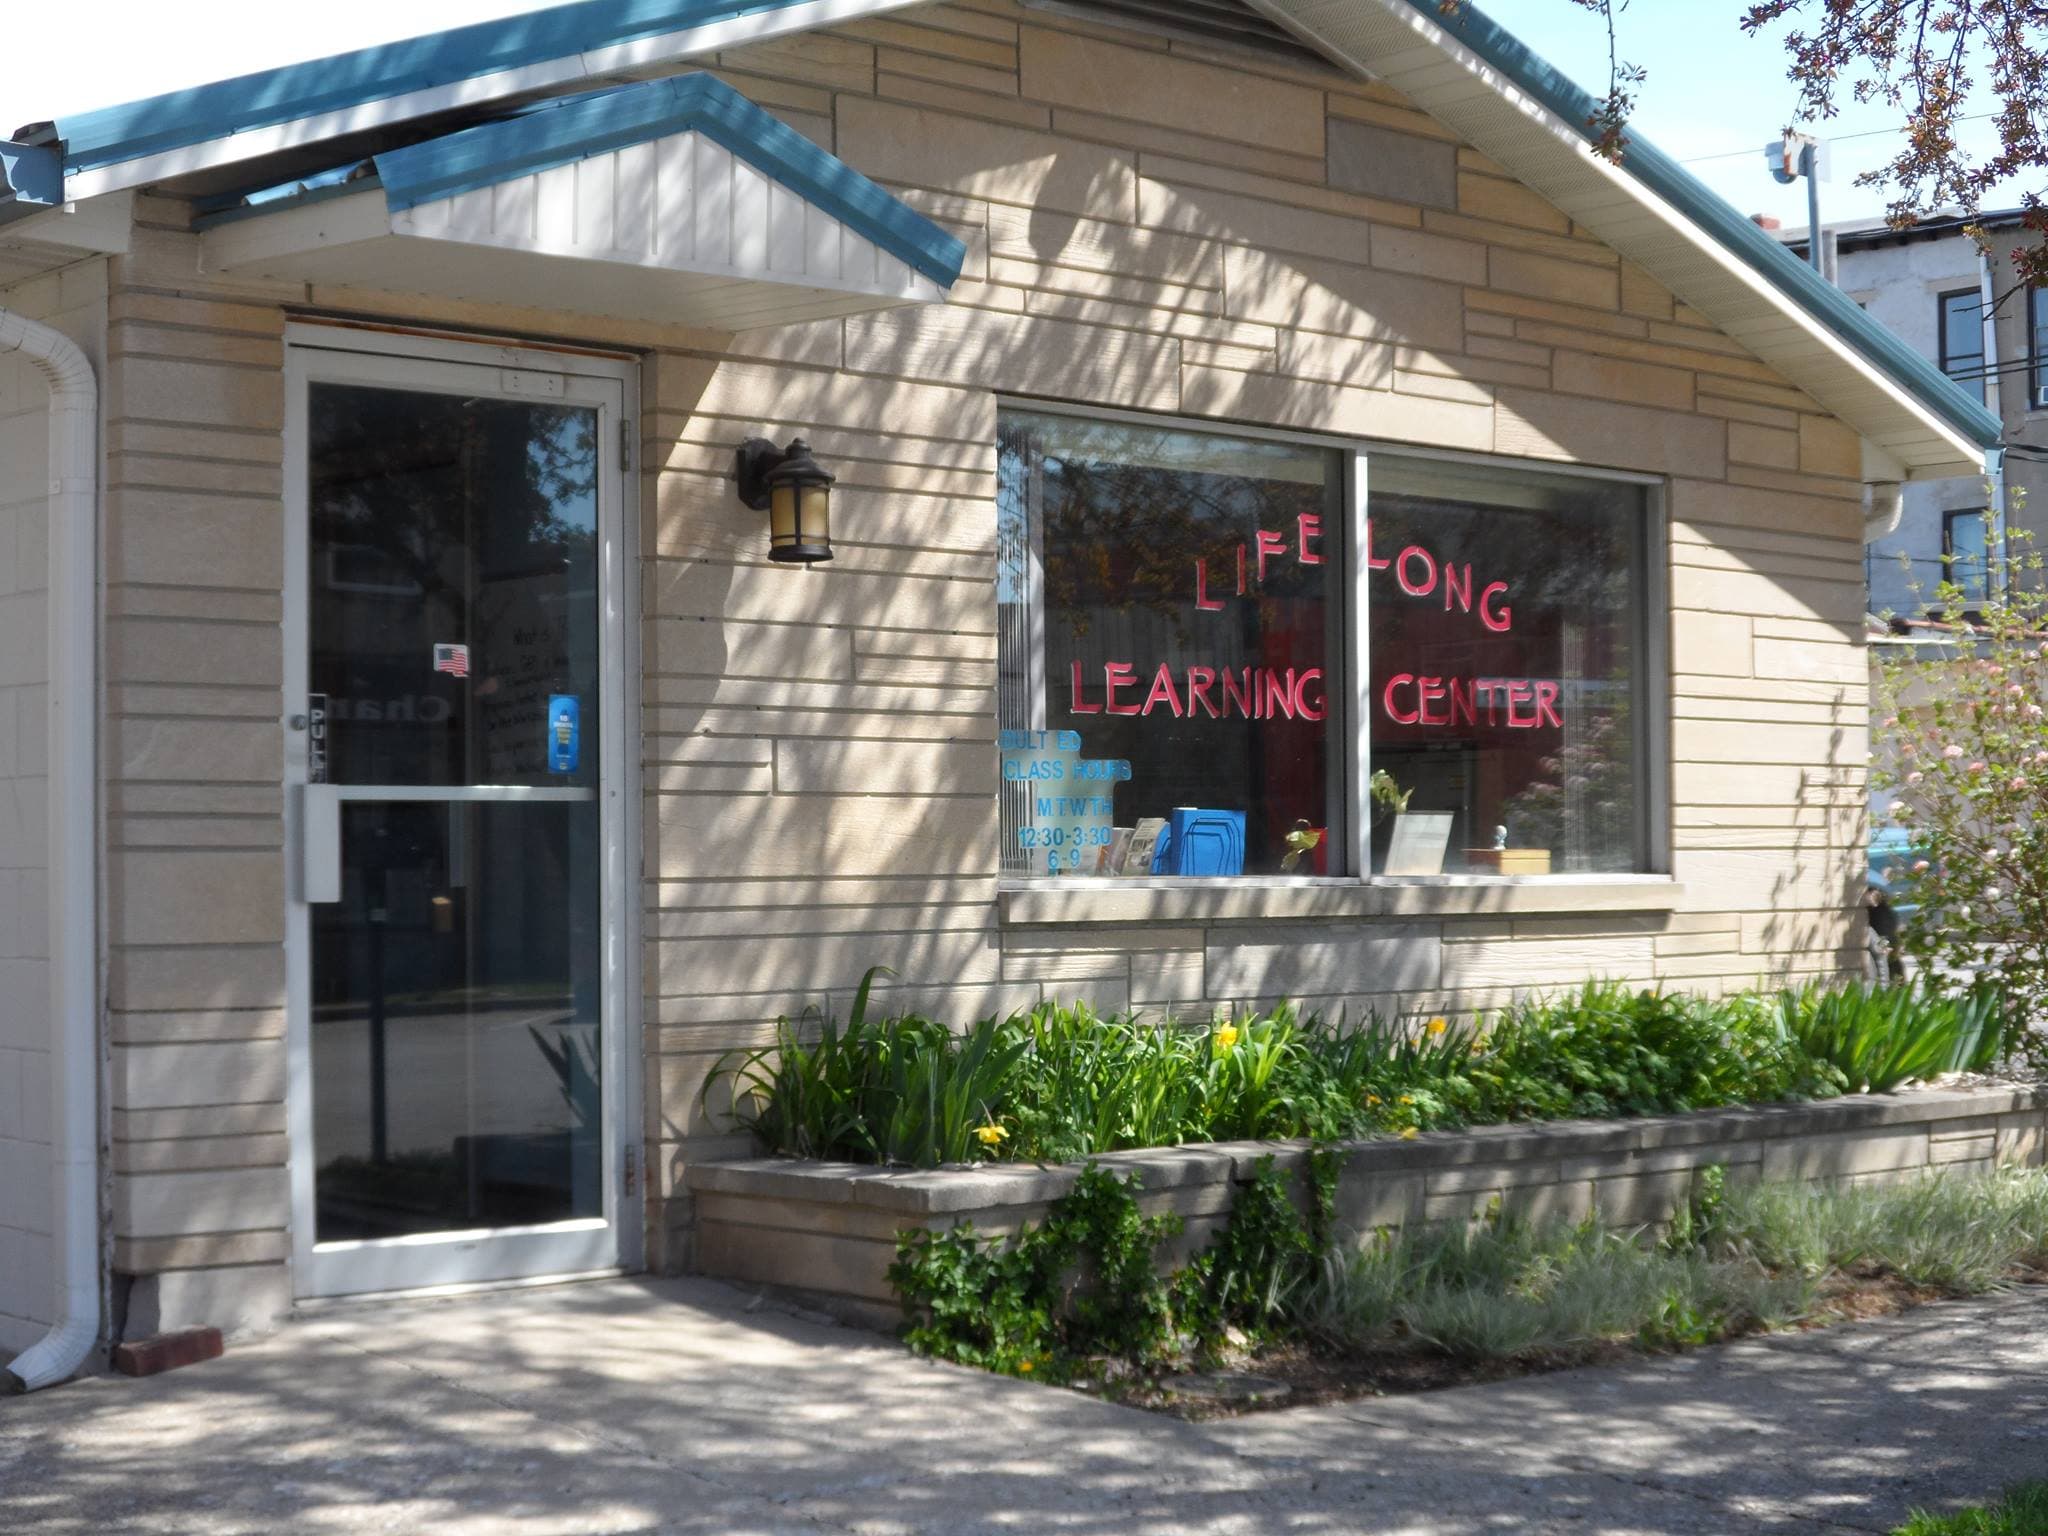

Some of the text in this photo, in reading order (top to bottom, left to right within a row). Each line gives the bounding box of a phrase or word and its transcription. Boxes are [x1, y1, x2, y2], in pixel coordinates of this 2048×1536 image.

[1070, 659, 1564, 728] LEARNING CENTER
[1058, 731, 1081, 751] ED
[1003, 760, 1131, 780] CLASS HOURS
